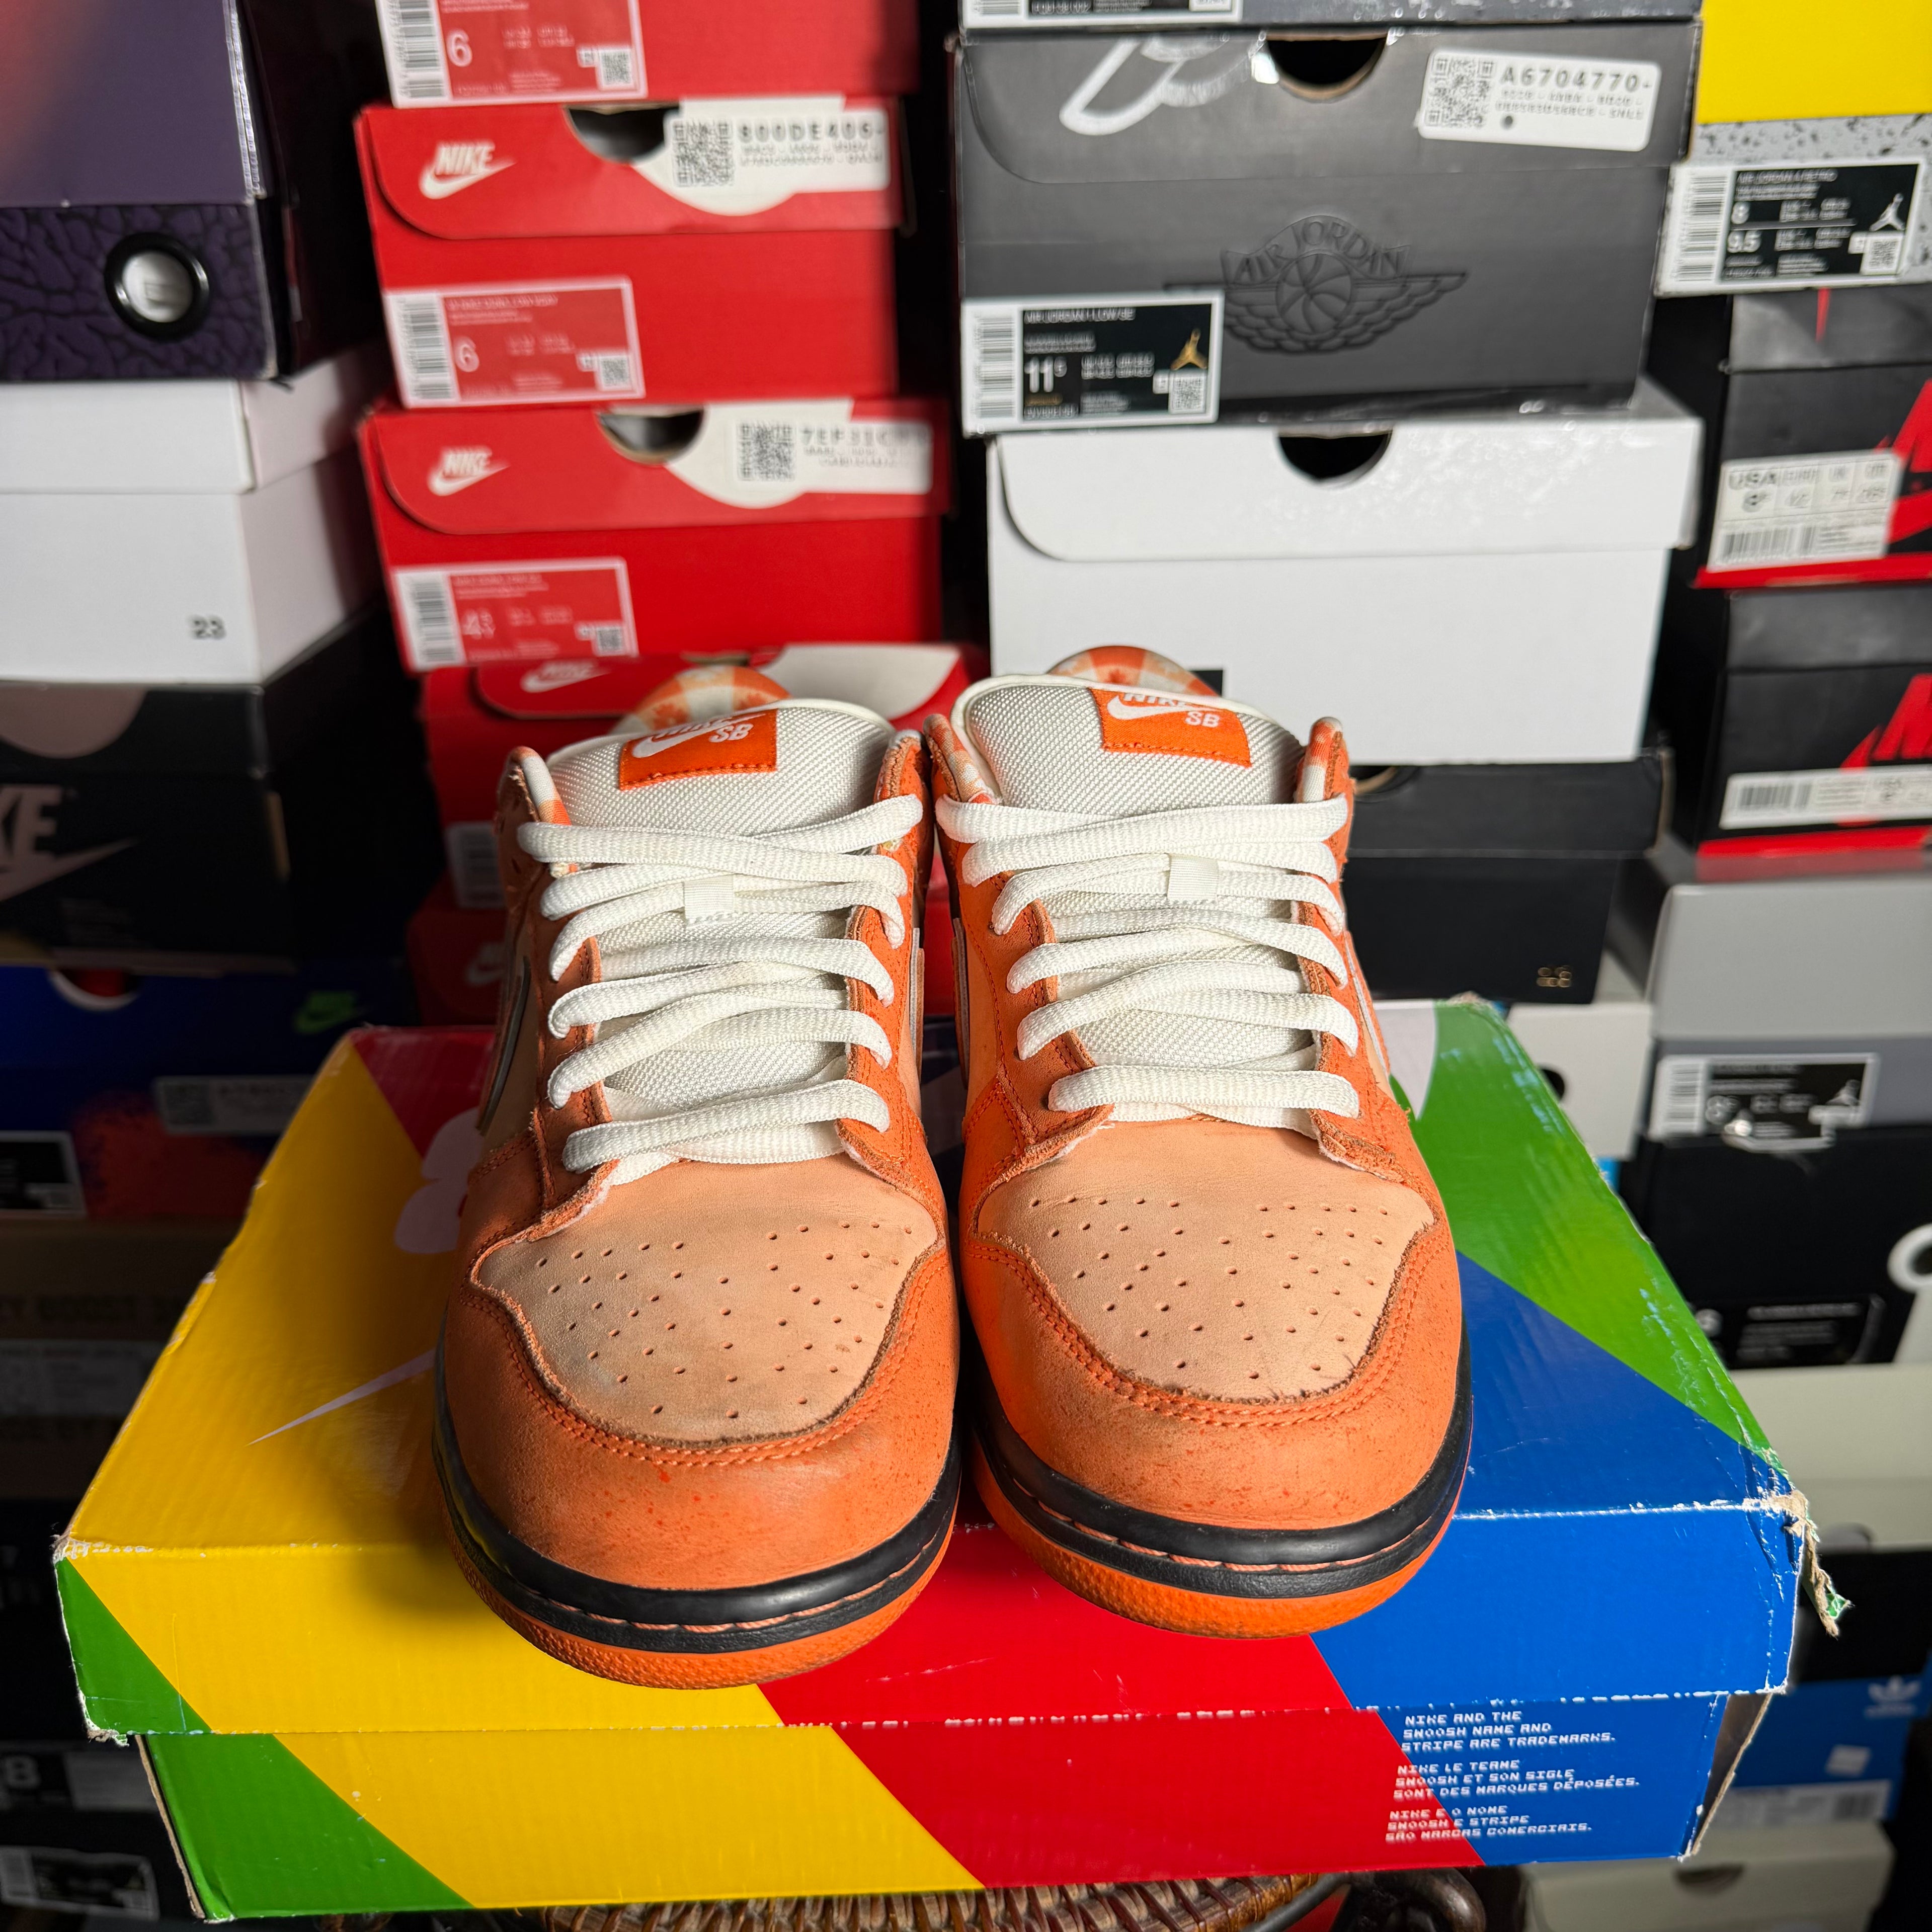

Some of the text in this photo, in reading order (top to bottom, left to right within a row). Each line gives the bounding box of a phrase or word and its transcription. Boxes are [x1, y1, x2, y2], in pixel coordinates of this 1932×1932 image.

[446, 29, 472, 66] 6
[434, 140, 495, 176] NIKE
[441, 445, 493, 477] NIKE
[1185, 710, 1221, 733] SB
[708, 723, 754, 743] SB
[1405, 1711, 1522, 1726] NIKE AND THE
[1472, 1725, 1514, 1736] NAME
[1520, 1723, 1552, 1734] AND
[1401, 1732, 1616, 1753] STRIPE ARE TRADEMARKS.
[1397, 1764, 1439, 1777] NIKE
[1444, 1763, 1463, 1774] LE
[1463, 1774, 1483, 1785] ET
[1489, 1772, 1520, 1783] SON
[1525, 1769, 1575, 1780] SIGLE
[1393, 1775, 1640, 1801] SONT DES MARQUES DÉPOSÉES.
[1390, 1809, 1430, 1821] NIKE
[1436, 1808, 1445, 1819] E
[1467, 1805, 1507, 1816] NOME
[1454, 1818, 1464, 1828] E
[1469, 1815, 1530, 1827] STRIPE
[1421, 1828, 1481, 1840] MARCAS
[1487, 1823, 1592, 1836] COMERCIAIS.
